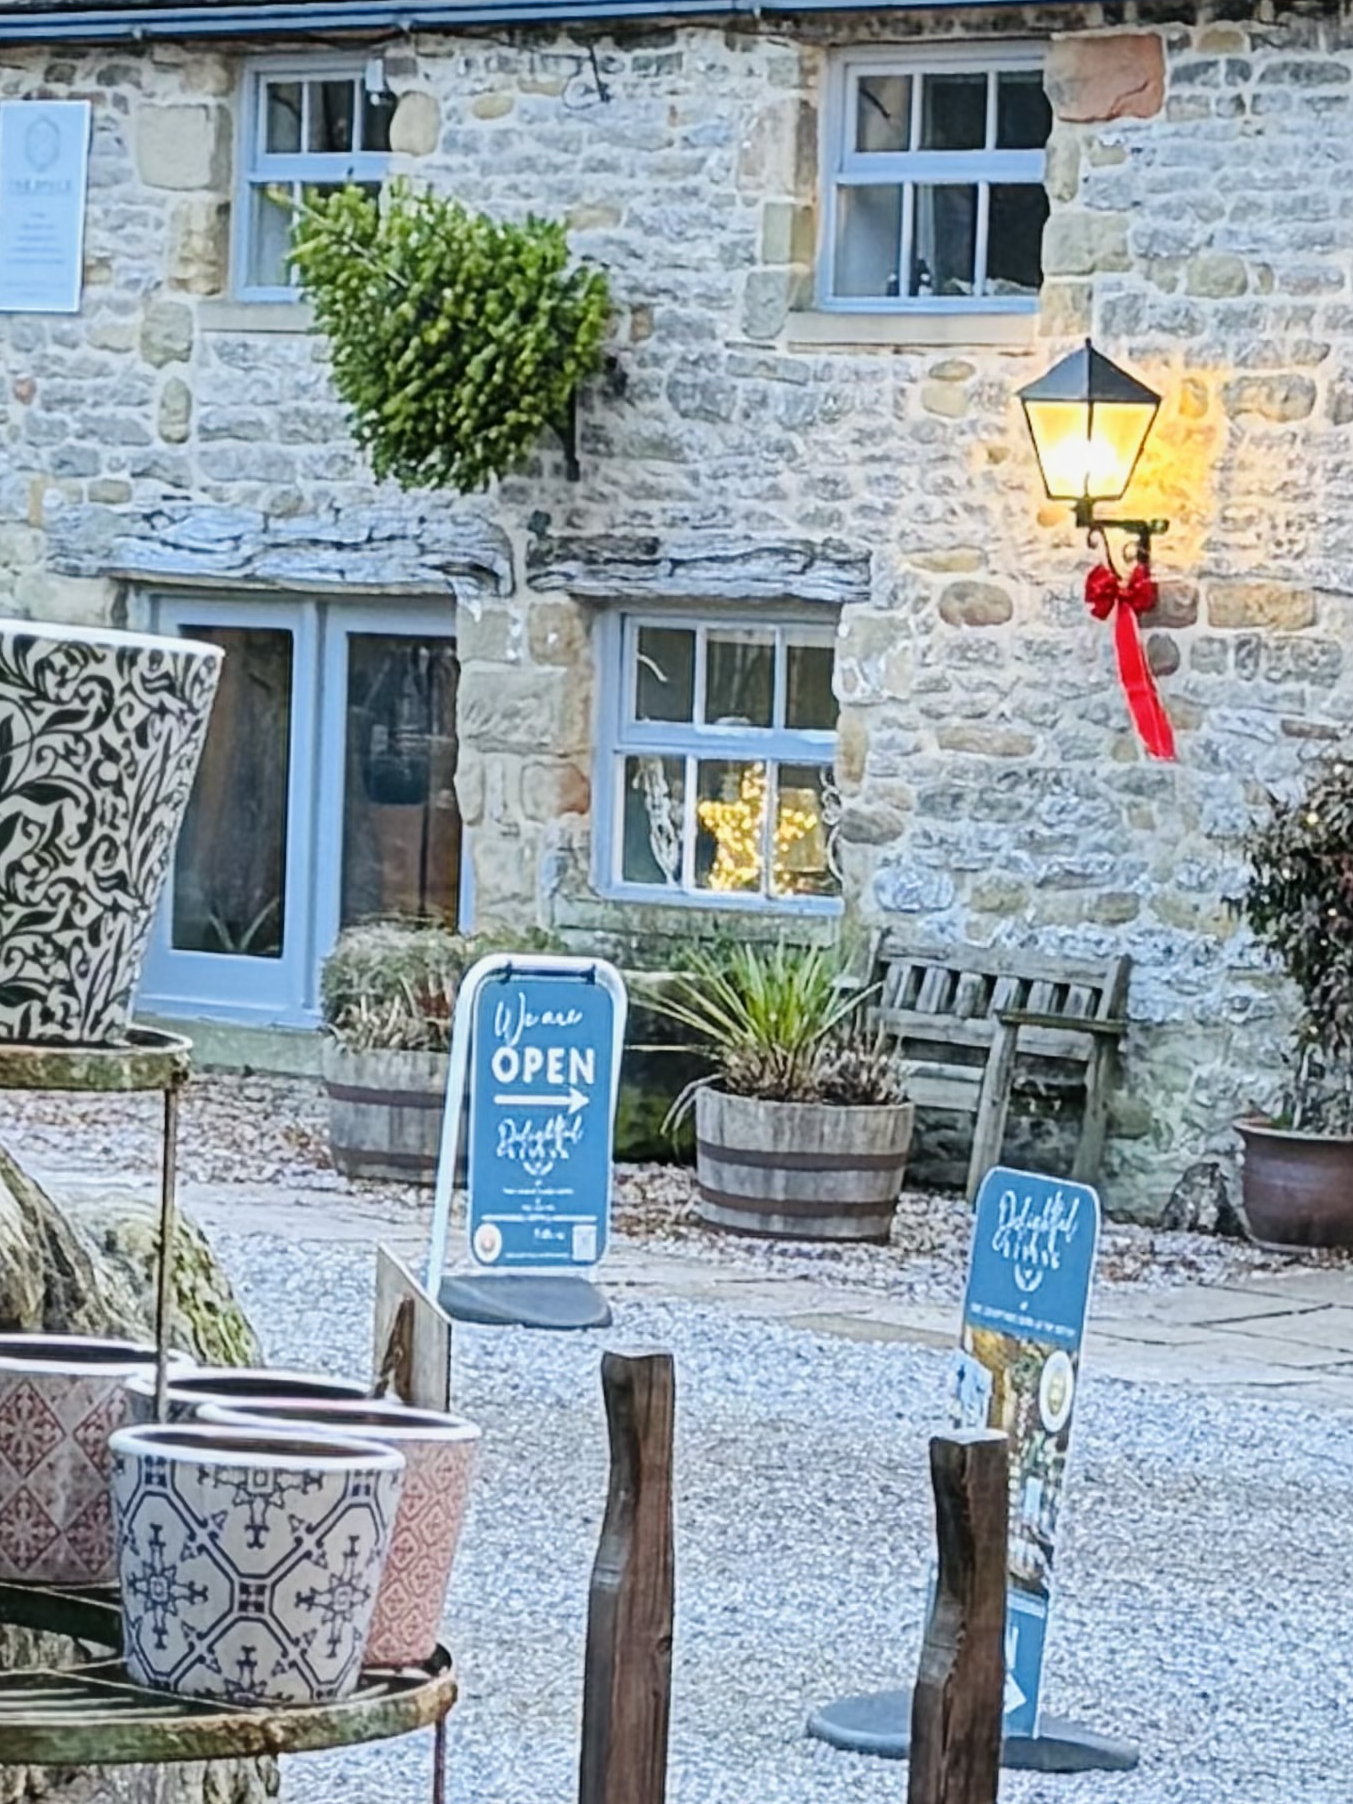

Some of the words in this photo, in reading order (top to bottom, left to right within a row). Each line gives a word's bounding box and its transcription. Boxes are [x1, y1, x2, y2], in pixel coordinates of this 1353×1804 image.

[494, 992, 539, 1047] We
[542, 1008, 583, 1027] are
[491, 1046, 596, 1084] OPEN
